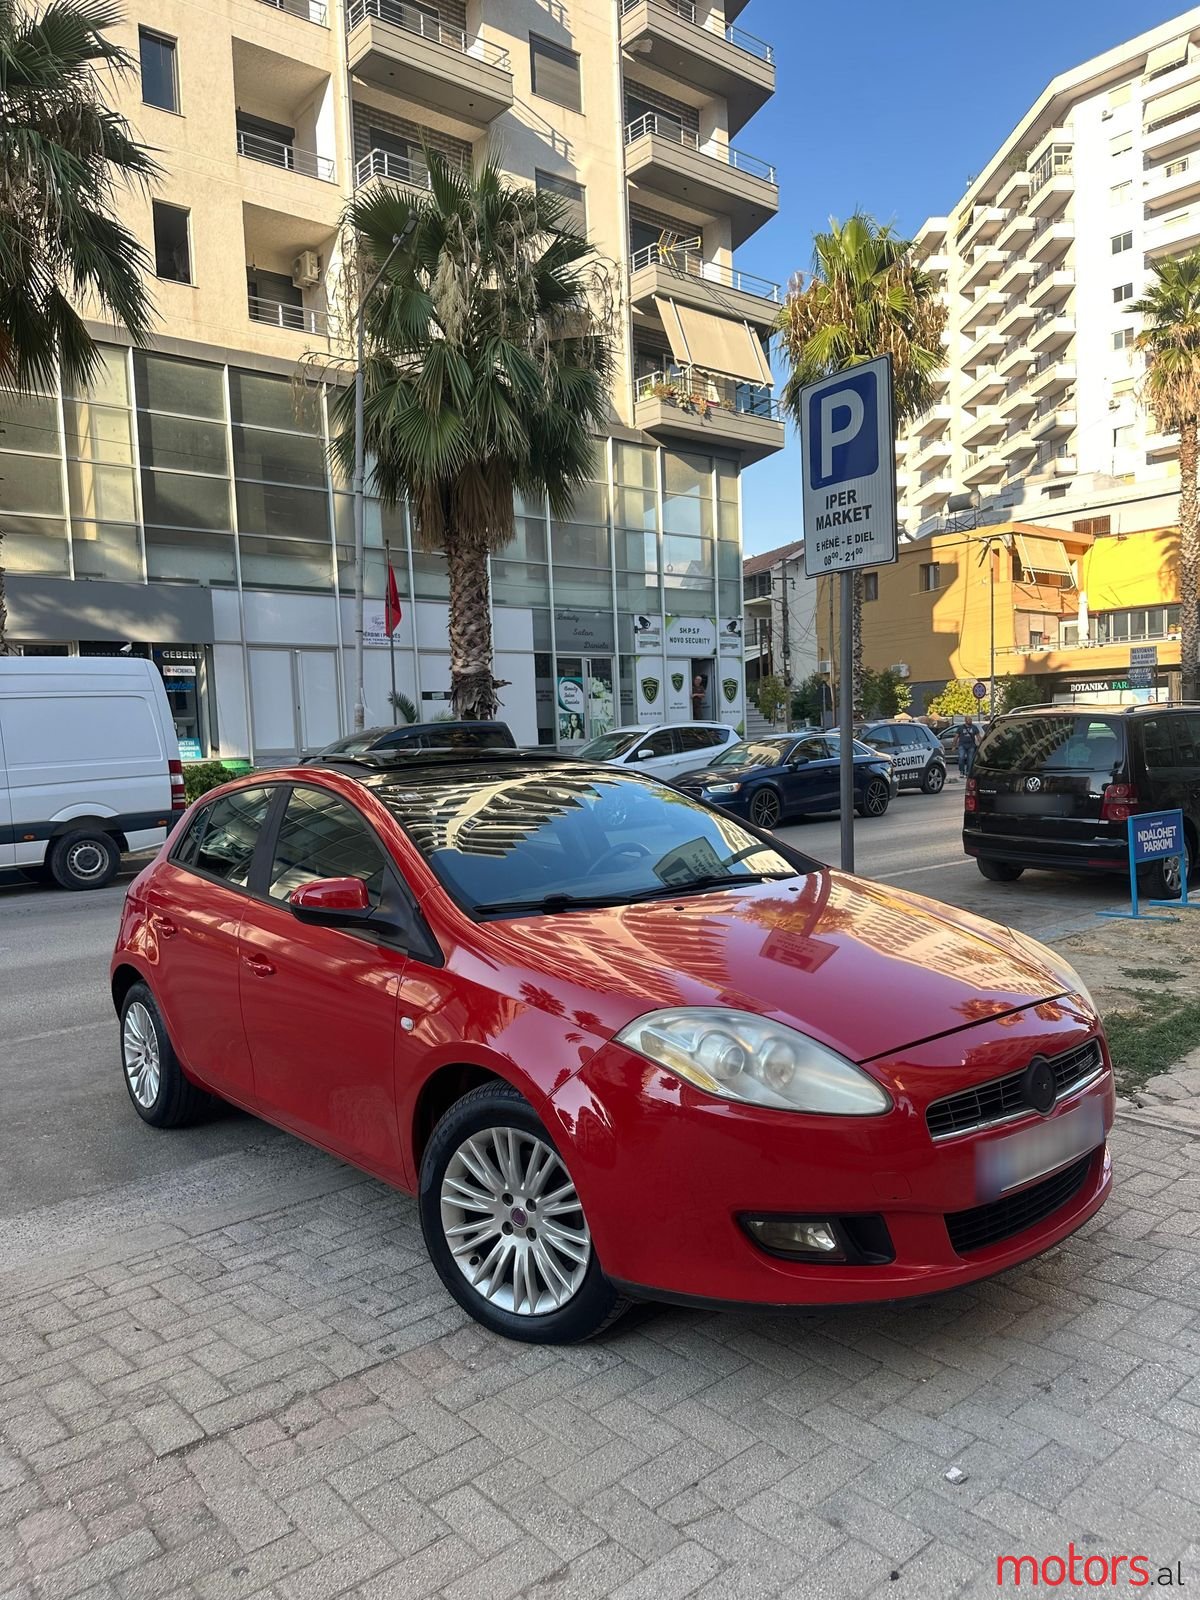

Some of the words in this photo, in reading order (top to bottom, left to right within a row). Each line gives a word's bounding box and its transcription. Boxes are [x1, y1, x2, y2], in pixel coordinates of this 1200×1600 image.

[821, 388, 865, 479] P
[826, 489, 857, 510] IPER
[816, 504, 872, 532] MARKET
[816, 542, 821, 552] E
[847, 535, 853, 545] E
[855, 531, 875, 544] DIEL
[573, 628, 593, 637] Salon
[162, 650, 203, 659] GEBERIT
[1070, 682, 1109, 692] BOTANIKA
[893, 755, 925, 767] SECURITY
[1137, 825, 1177, 842] NDALOHET
[1143, 837, 1173, 853] PARKIMI
